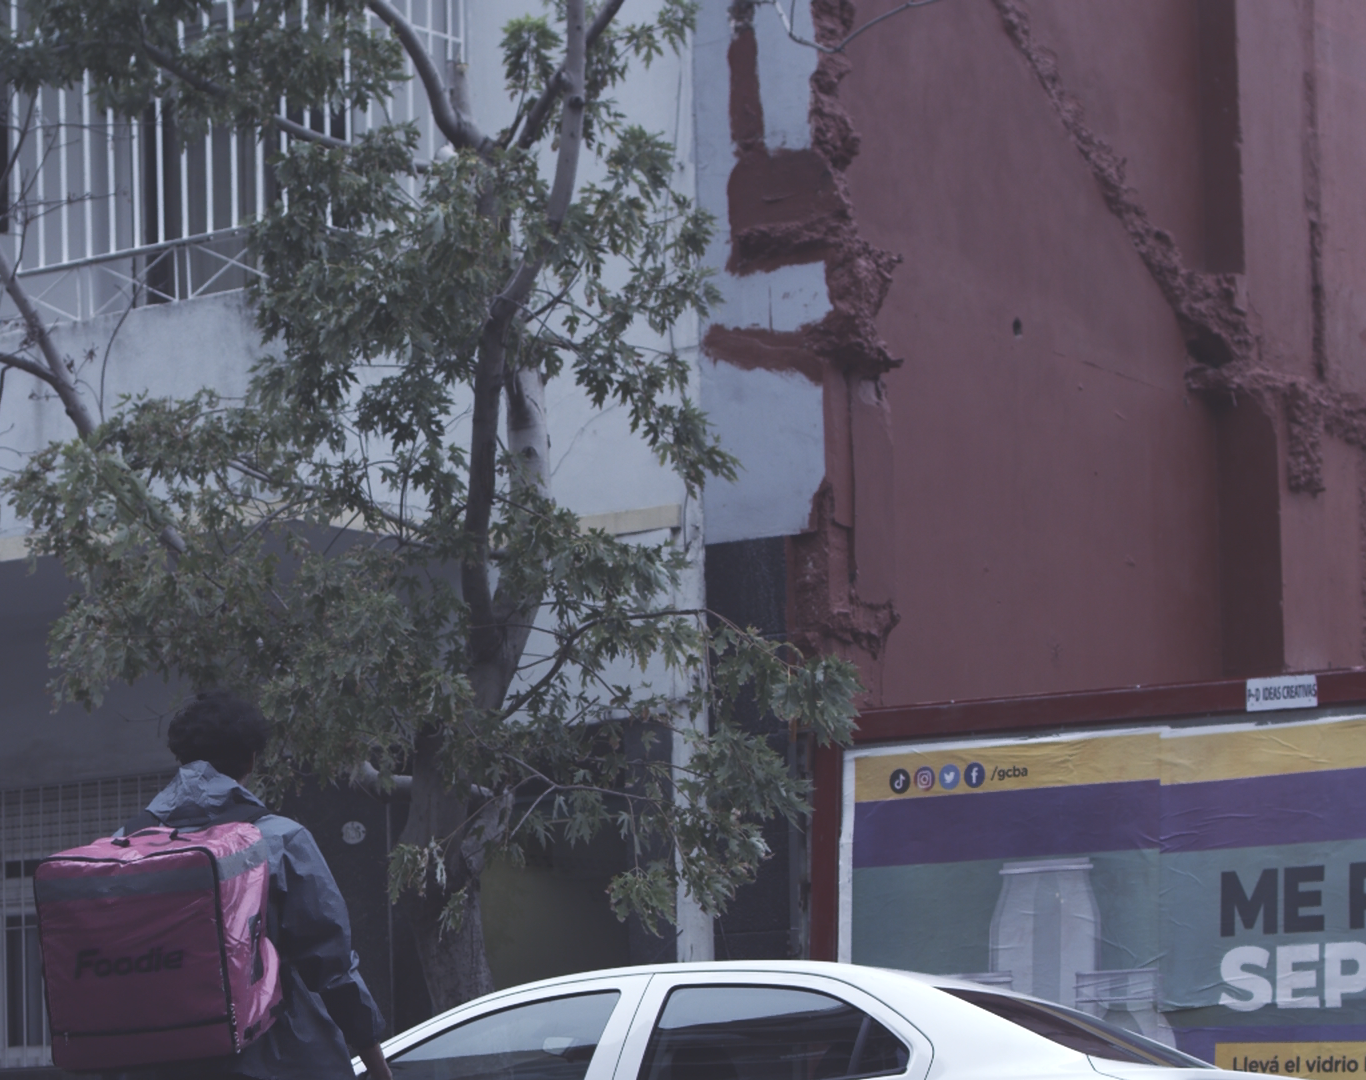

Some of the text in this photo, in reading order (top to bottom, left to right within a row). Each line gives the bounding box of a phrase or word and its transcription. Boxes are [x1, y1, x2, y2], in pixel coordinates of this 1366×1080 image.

[1262, 686, 1281, 701] IDEAS
[1282, 683, 1317, 699] CREATIVAS
[990, 765, 1028, 781] /gcba
[1220, 865, 1326, 938] ME
[74, 946, 186, 980] Foodie
[1233, 1054, 1279, 1073] Llevá
[1284, 1055, 1300, 1073] el
[1306, 1054, 1358, 1073] vidrio
